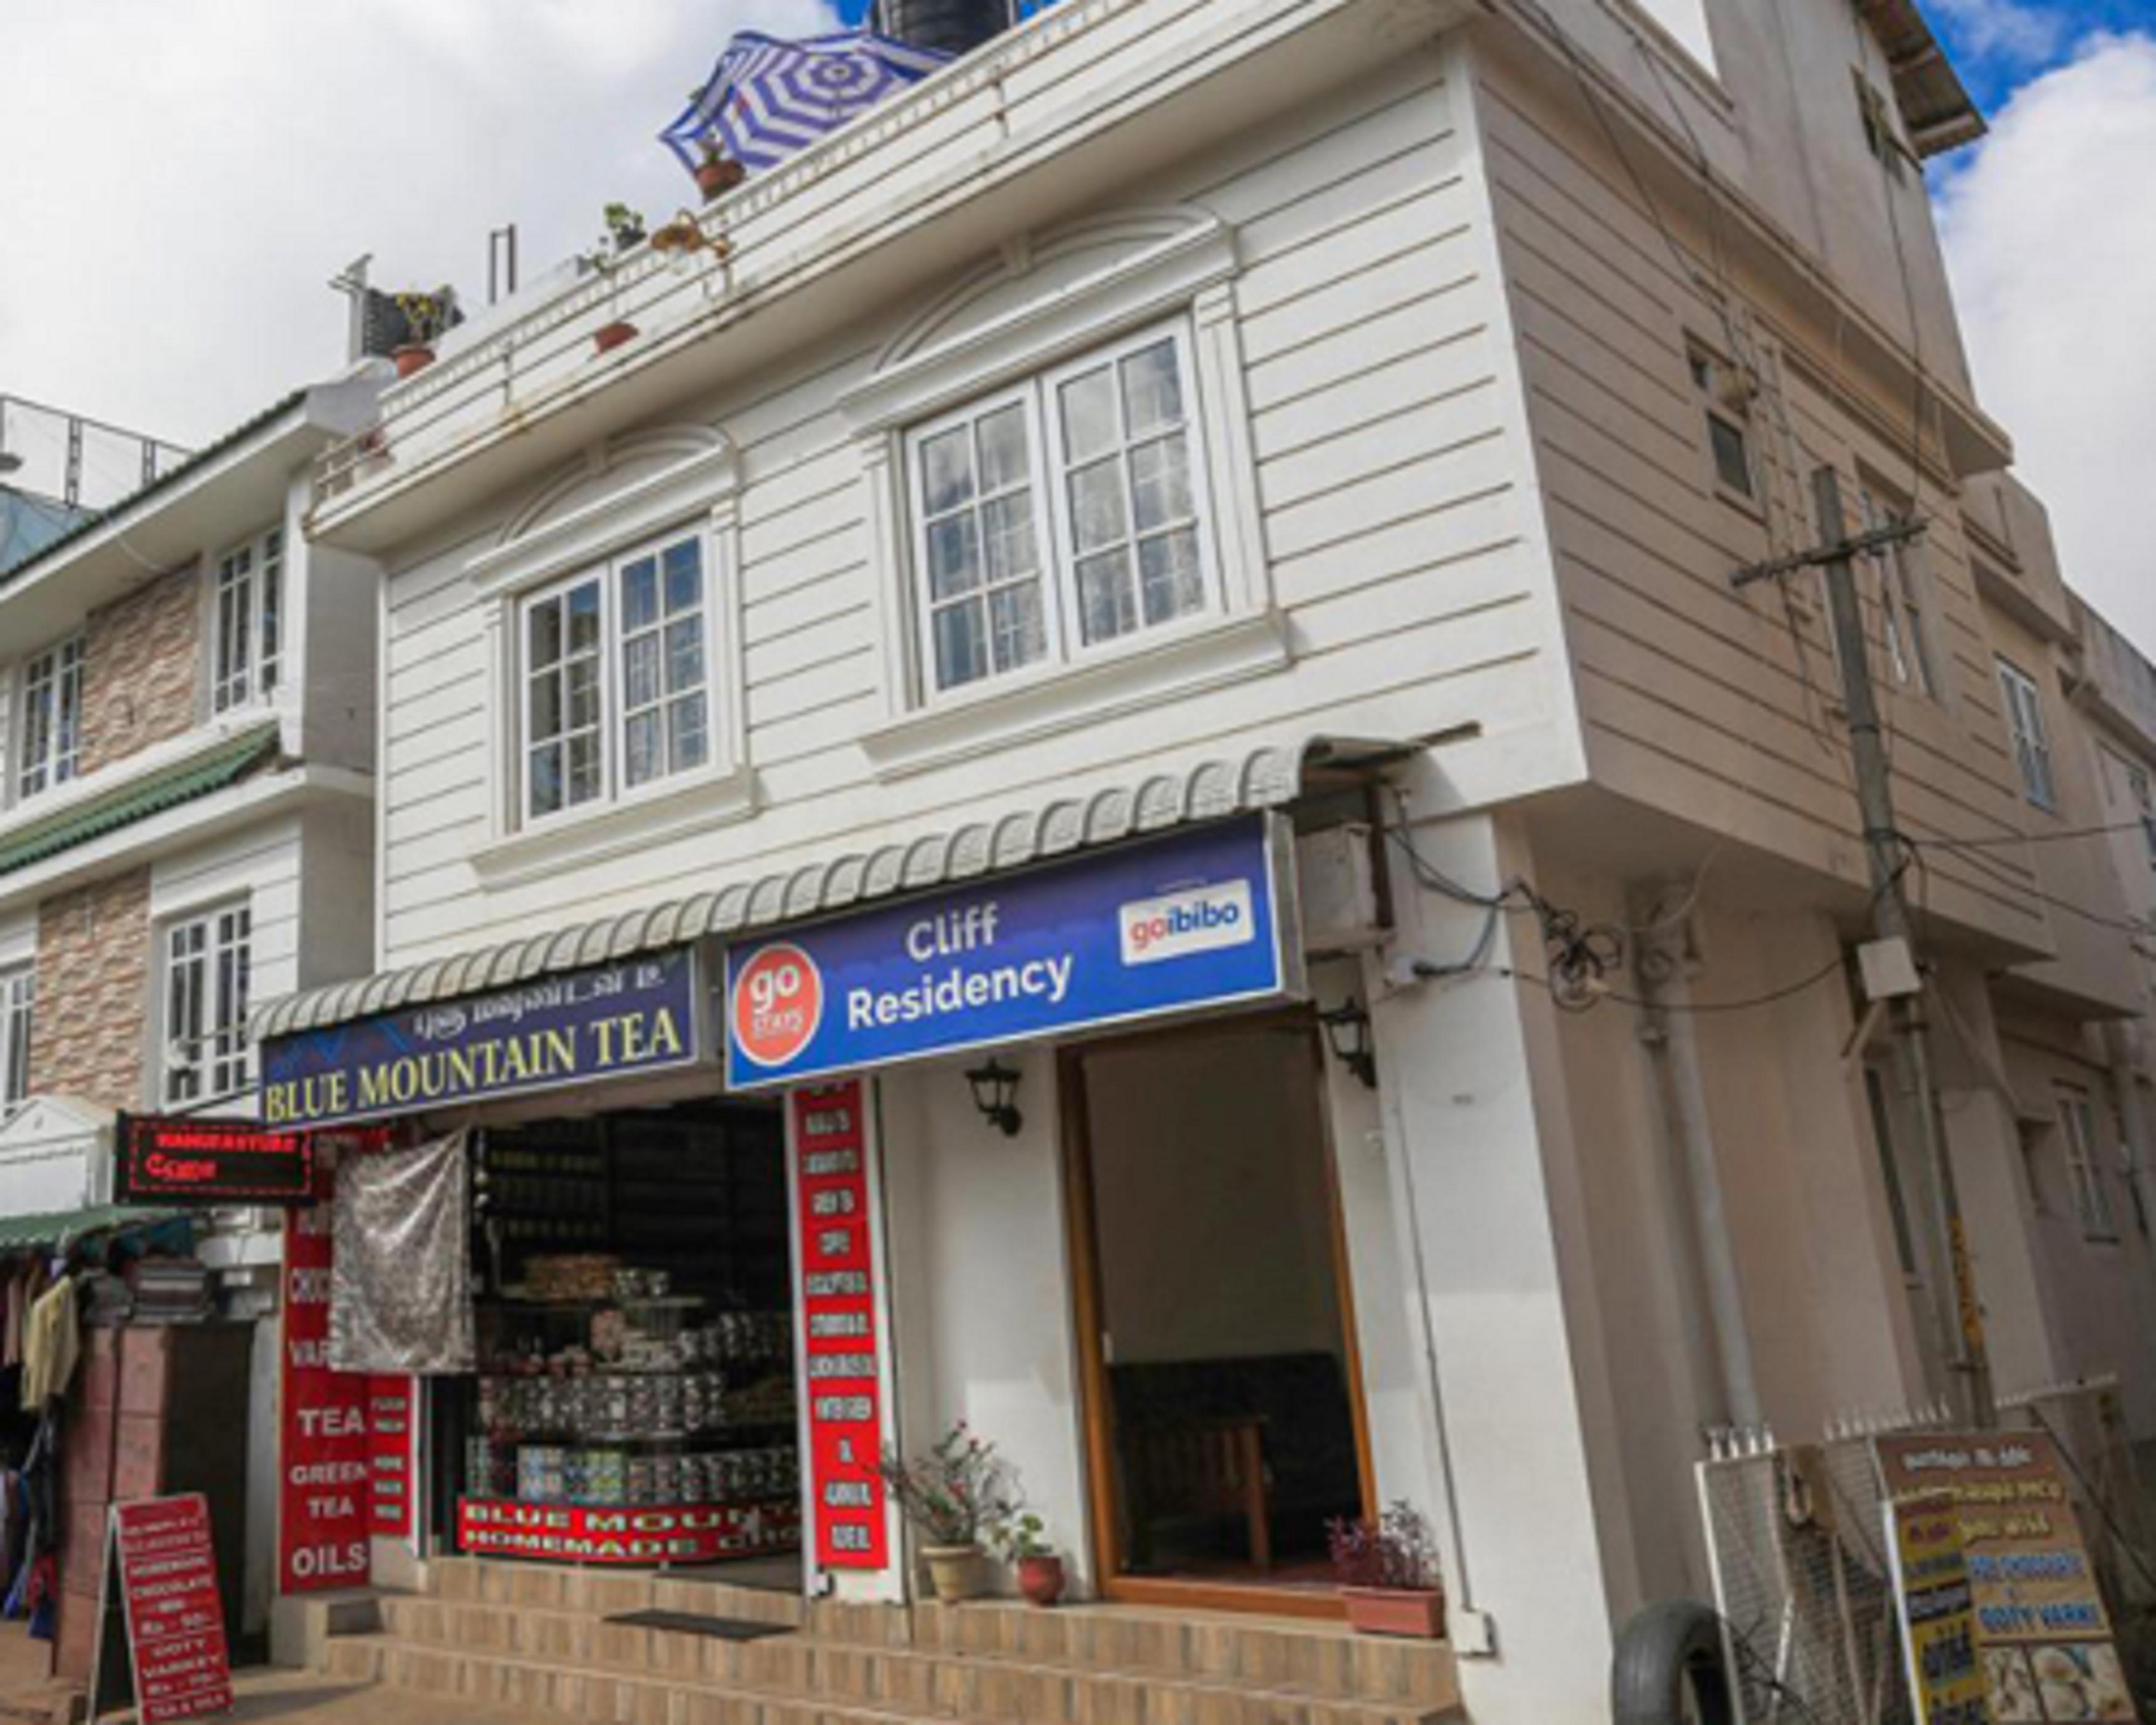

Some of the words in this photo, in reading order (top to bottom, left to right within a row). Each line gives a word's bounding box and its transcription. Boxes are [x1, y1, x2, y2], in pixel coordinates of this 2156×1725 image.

[906, 901, 1000, 961] Cliff
[1129, 900, 1239, 951] goibibo
[750, 964, 800, 1015] go
[847, 953, 1073, 1030] Residency
[265, 1068, 349, 1122] BLUE
[359, 1025, 577, 1109] MOUNTAIN
[589, 1007, 682, 1065] TEA
[297, 1408, 367, 1437] TEA
[290, 1461, 369, 1486] GREEN
[307, 1495, 355, 1519] TEA
[464, 1502, 570, 1528] BLUE
[292, 1541, 368, 1577] OILS
[464, 1530, 699, 1557] HOMEMADE
